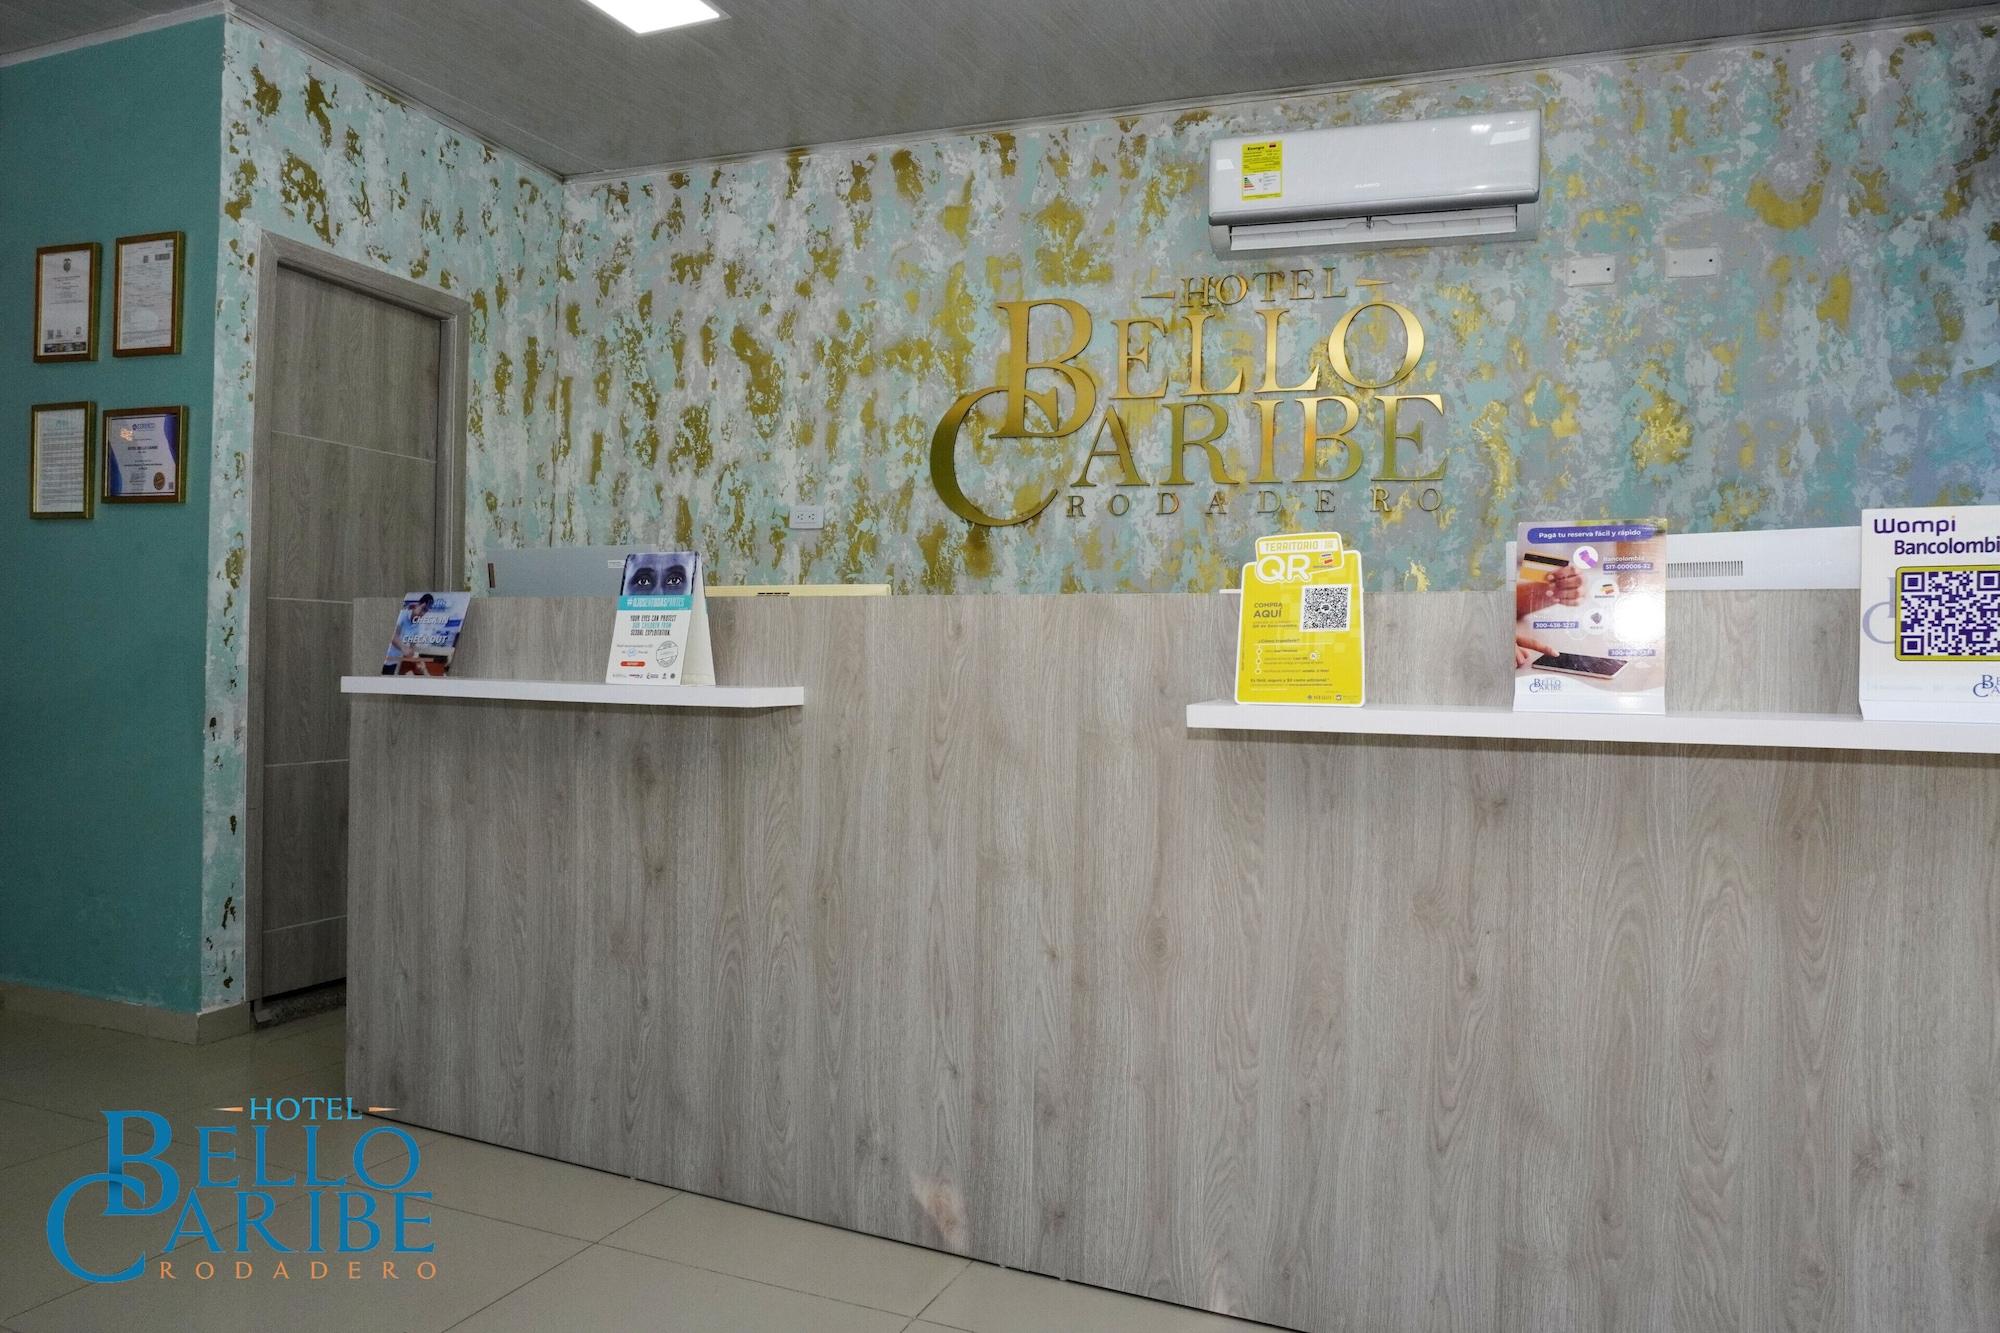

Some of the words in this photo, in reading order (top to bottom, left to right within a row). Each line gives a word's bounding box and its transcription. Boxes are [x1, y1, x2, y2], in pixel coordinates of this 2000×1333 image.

[1179, 267, 1348, 307] HOTEL
[988, 299, 1425, 439] BELLO
[930, 386, 1448, 526] CARIBE
[1066, 487, 1442, 518] RODADERO
[1611, 531, 1617, 539] y
[1618, 529, 1642, 539] rápido
[1874, 516, 1956, 536] Wompi
[1265, 541, 1319, 551] TERRITORIO
[1894, 536, 2000, 555] Bancolombi
[1257, 554, 1312, 582] QR
[412, 616, 438, 624] CHECK
[1253, 608, 1282, 618] AQUÍ
[402, 634, 428, 644] CHECK
[430, 635, 448, 643] OUT
